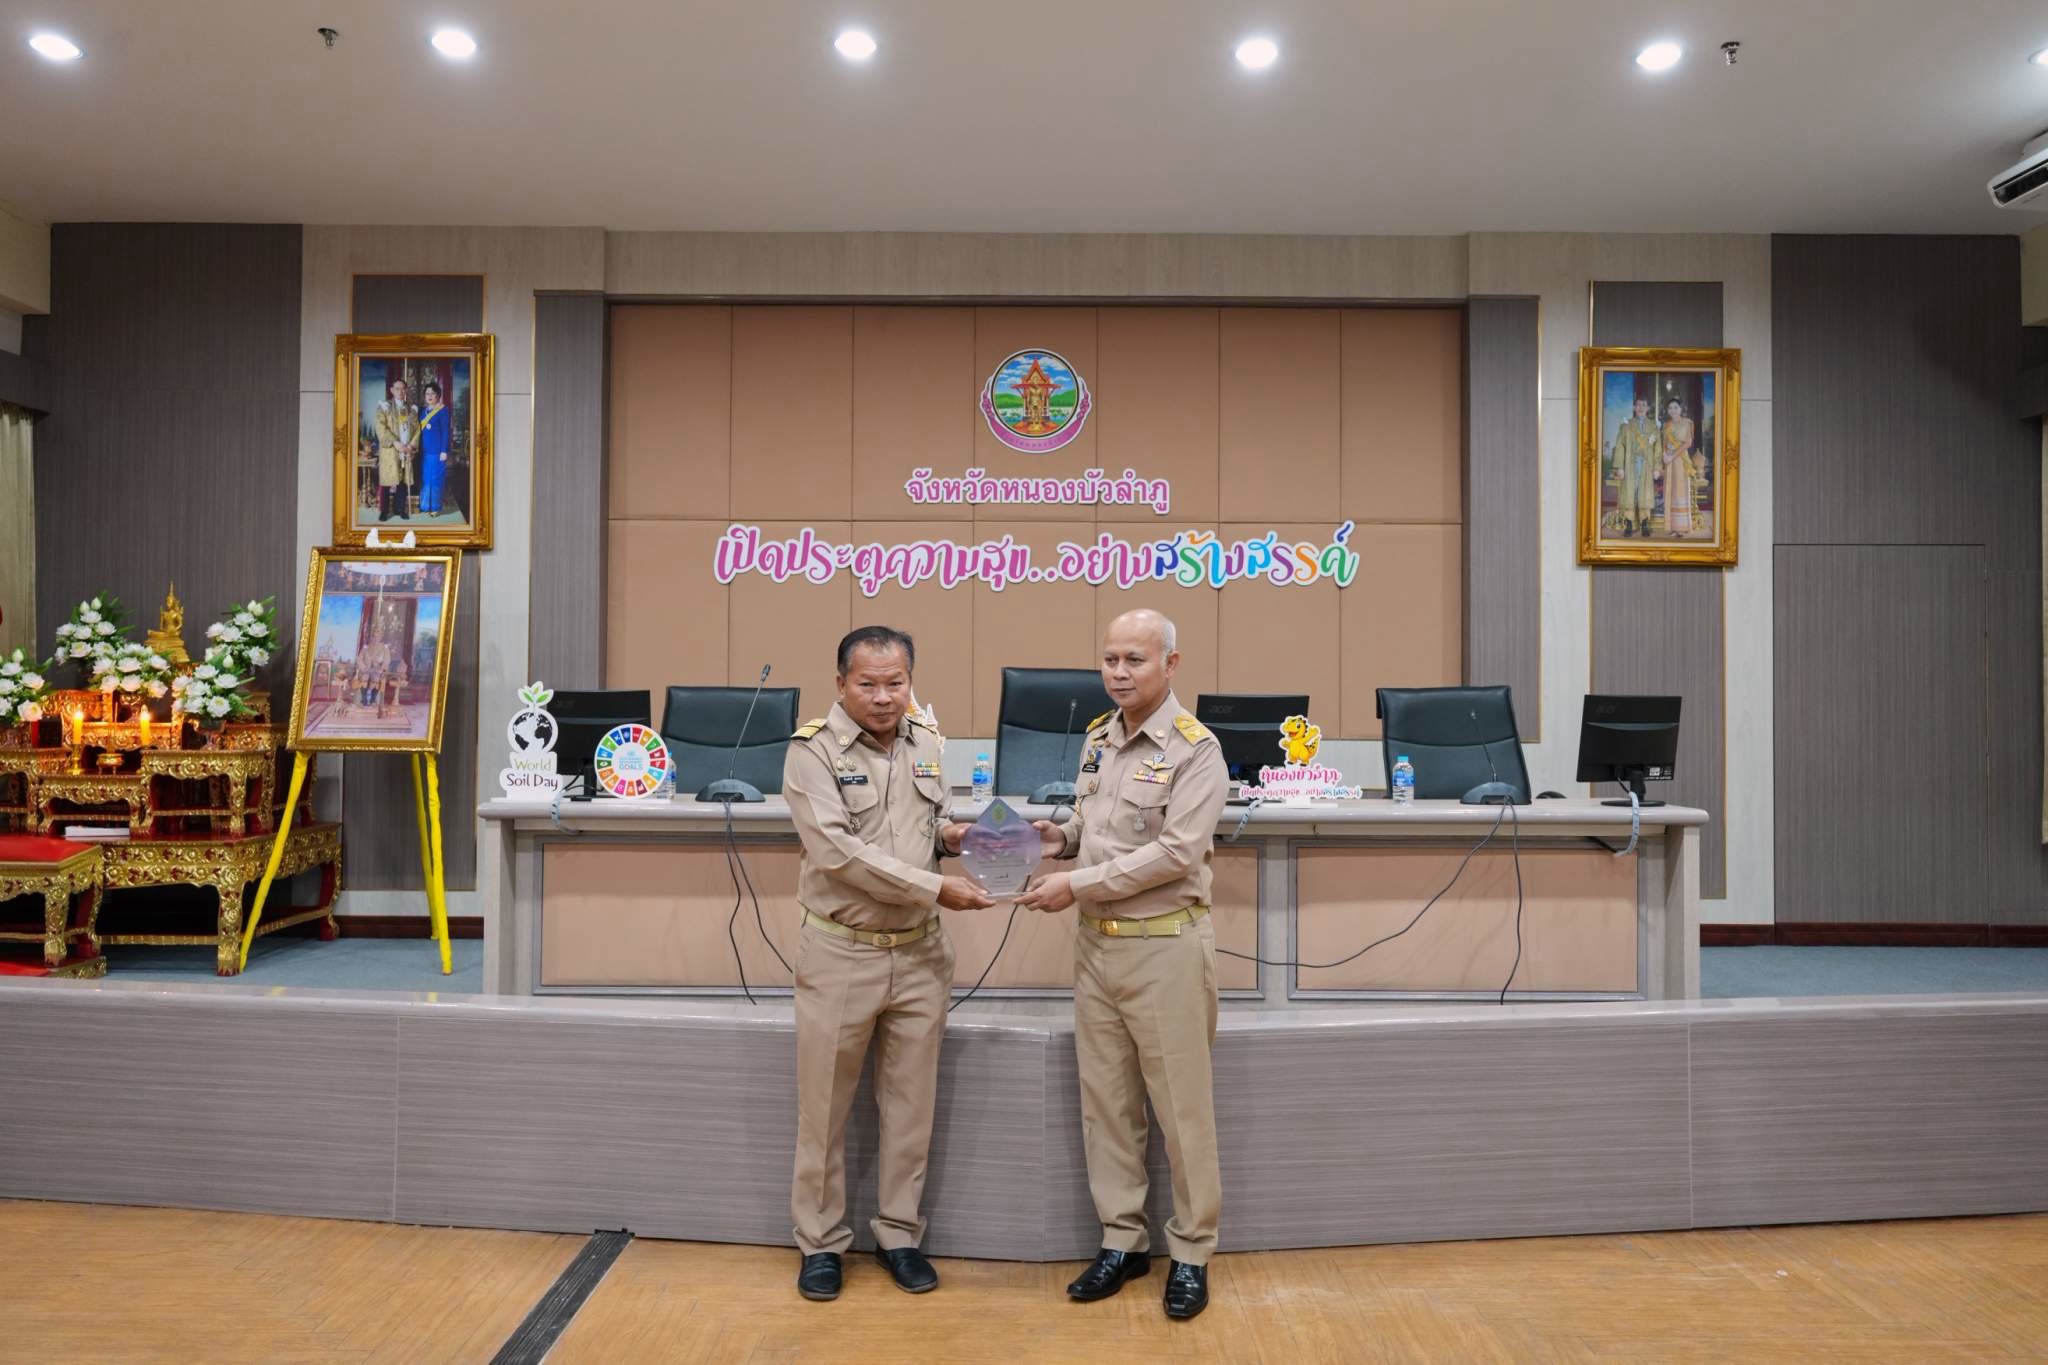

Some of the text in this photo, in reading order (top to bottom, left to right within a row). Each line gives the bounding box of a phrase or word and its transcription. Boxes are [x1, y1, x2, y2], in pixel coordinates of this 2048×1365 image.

[908, 470, 1168, 512] จังหวัดหนองบัวลำภู
[514, 759, 551, 770] World
[506, 773, 558, 791] Soil Day
